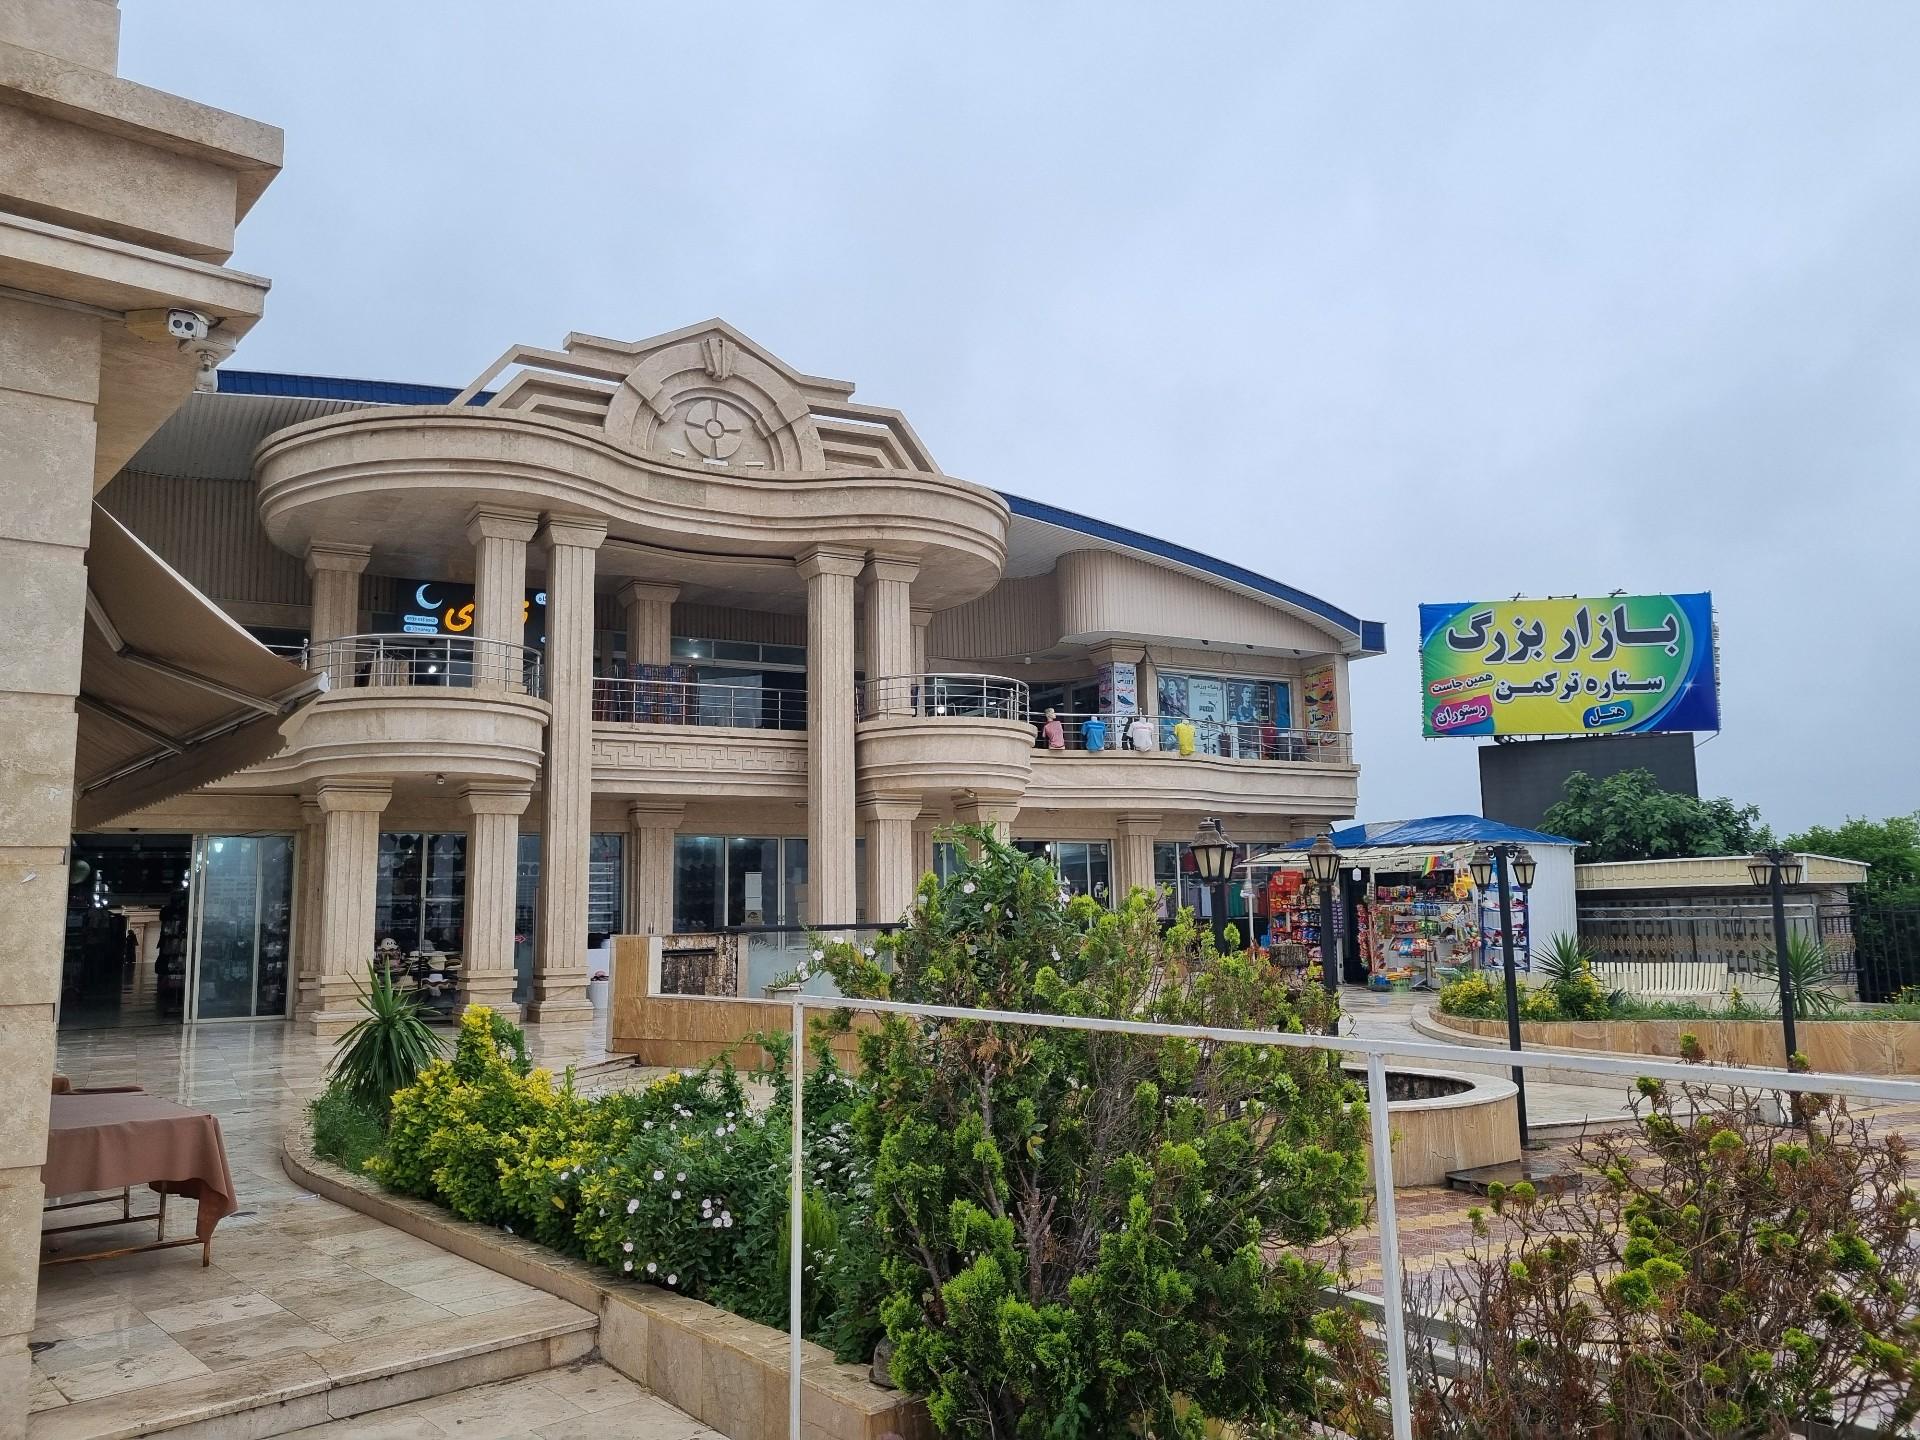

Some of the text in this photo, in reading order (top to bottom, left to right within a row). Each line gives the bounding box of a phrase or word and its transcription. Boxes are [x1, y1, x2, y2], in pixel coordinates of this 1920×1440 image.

[1448, 604, 1679, 663] بازار بزرگ
[1430, 673, 1494, 694] همین جاست
[1494, 669, 1664, 700] ستاره ترکمن
[1435, 704, 1488, 726] رستوران
[1589, 705, 1626, 726] هتل
